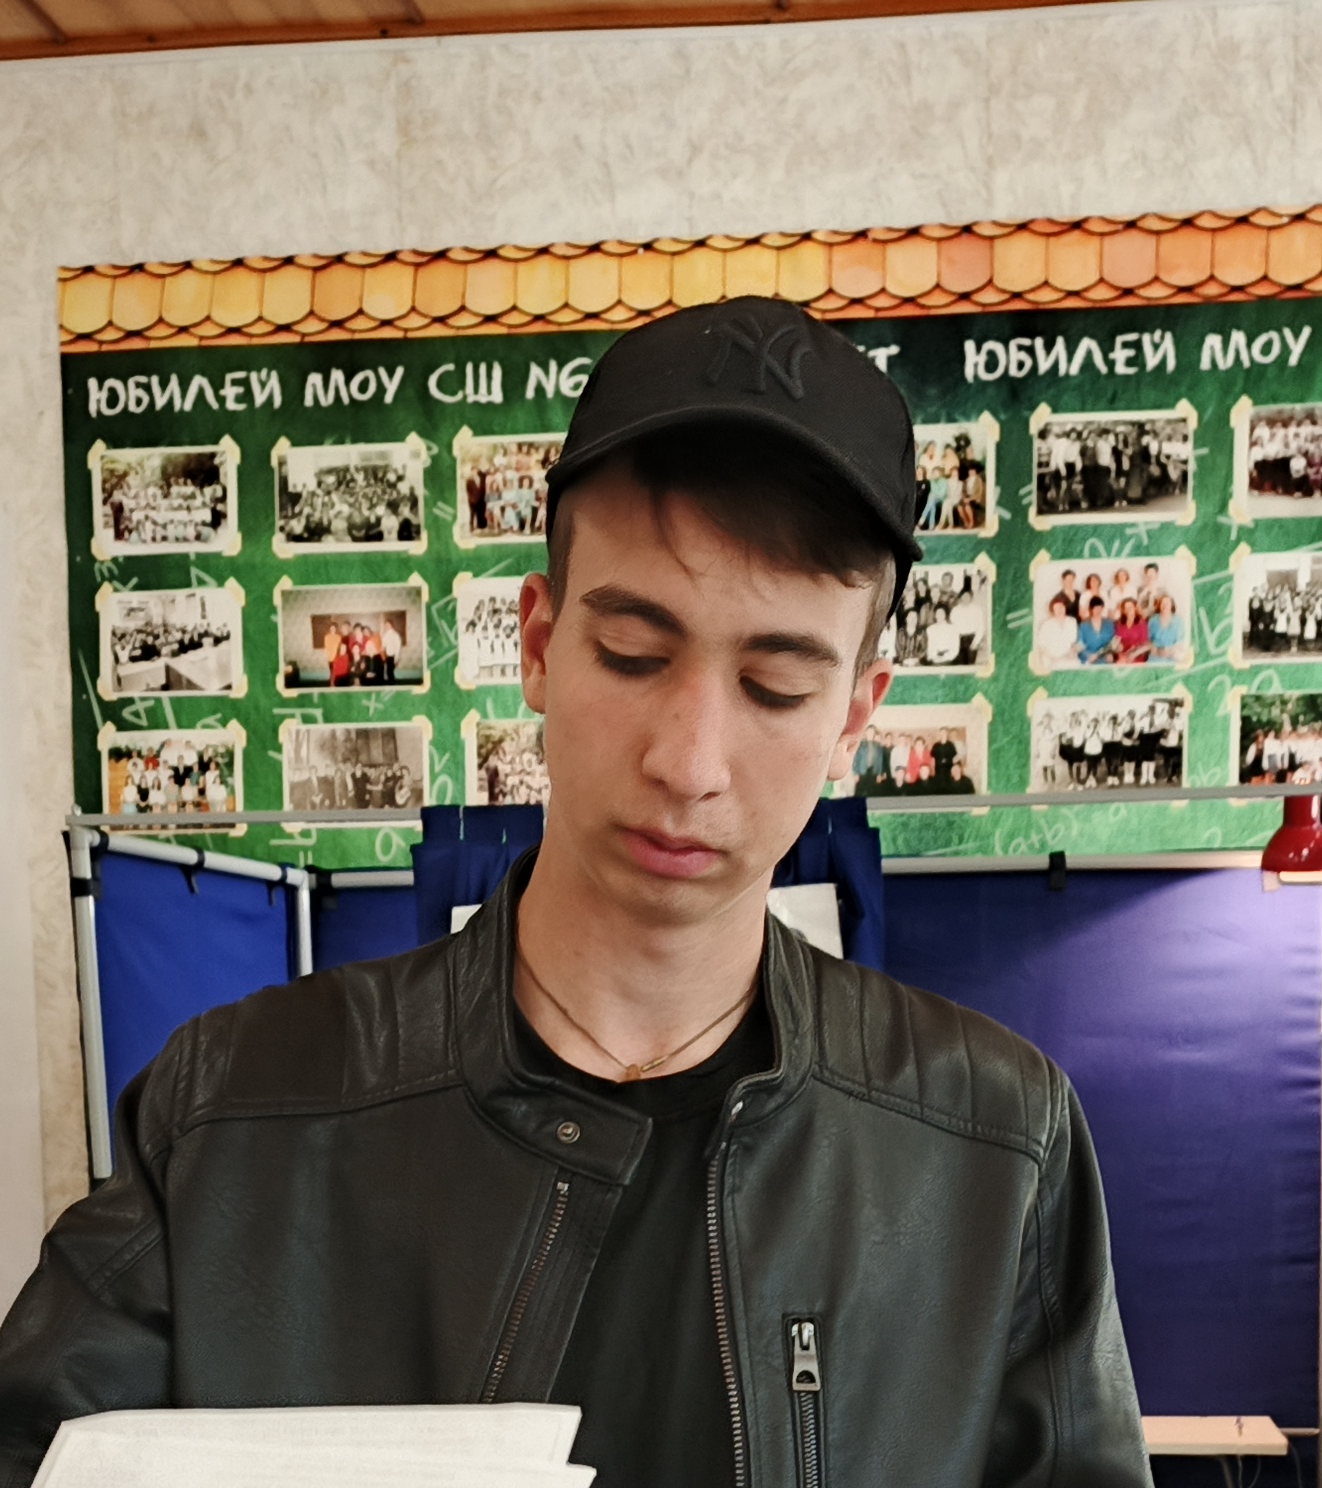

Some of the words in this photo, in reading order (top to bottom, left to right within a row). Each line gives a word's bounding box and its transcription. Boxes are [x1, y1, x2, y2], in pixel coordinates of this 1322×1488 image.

[963, 328, 1176, 384] ЮБИЛЕЙ
[1199, 325, 1312, 371] МОУ
[87, 366, 283, 418] ЮБИЛЕЙ
[303, 364, 405, 408] МОУ
[427, 360, 504, 404] СШ
[525, 357, 593, 400] N6
